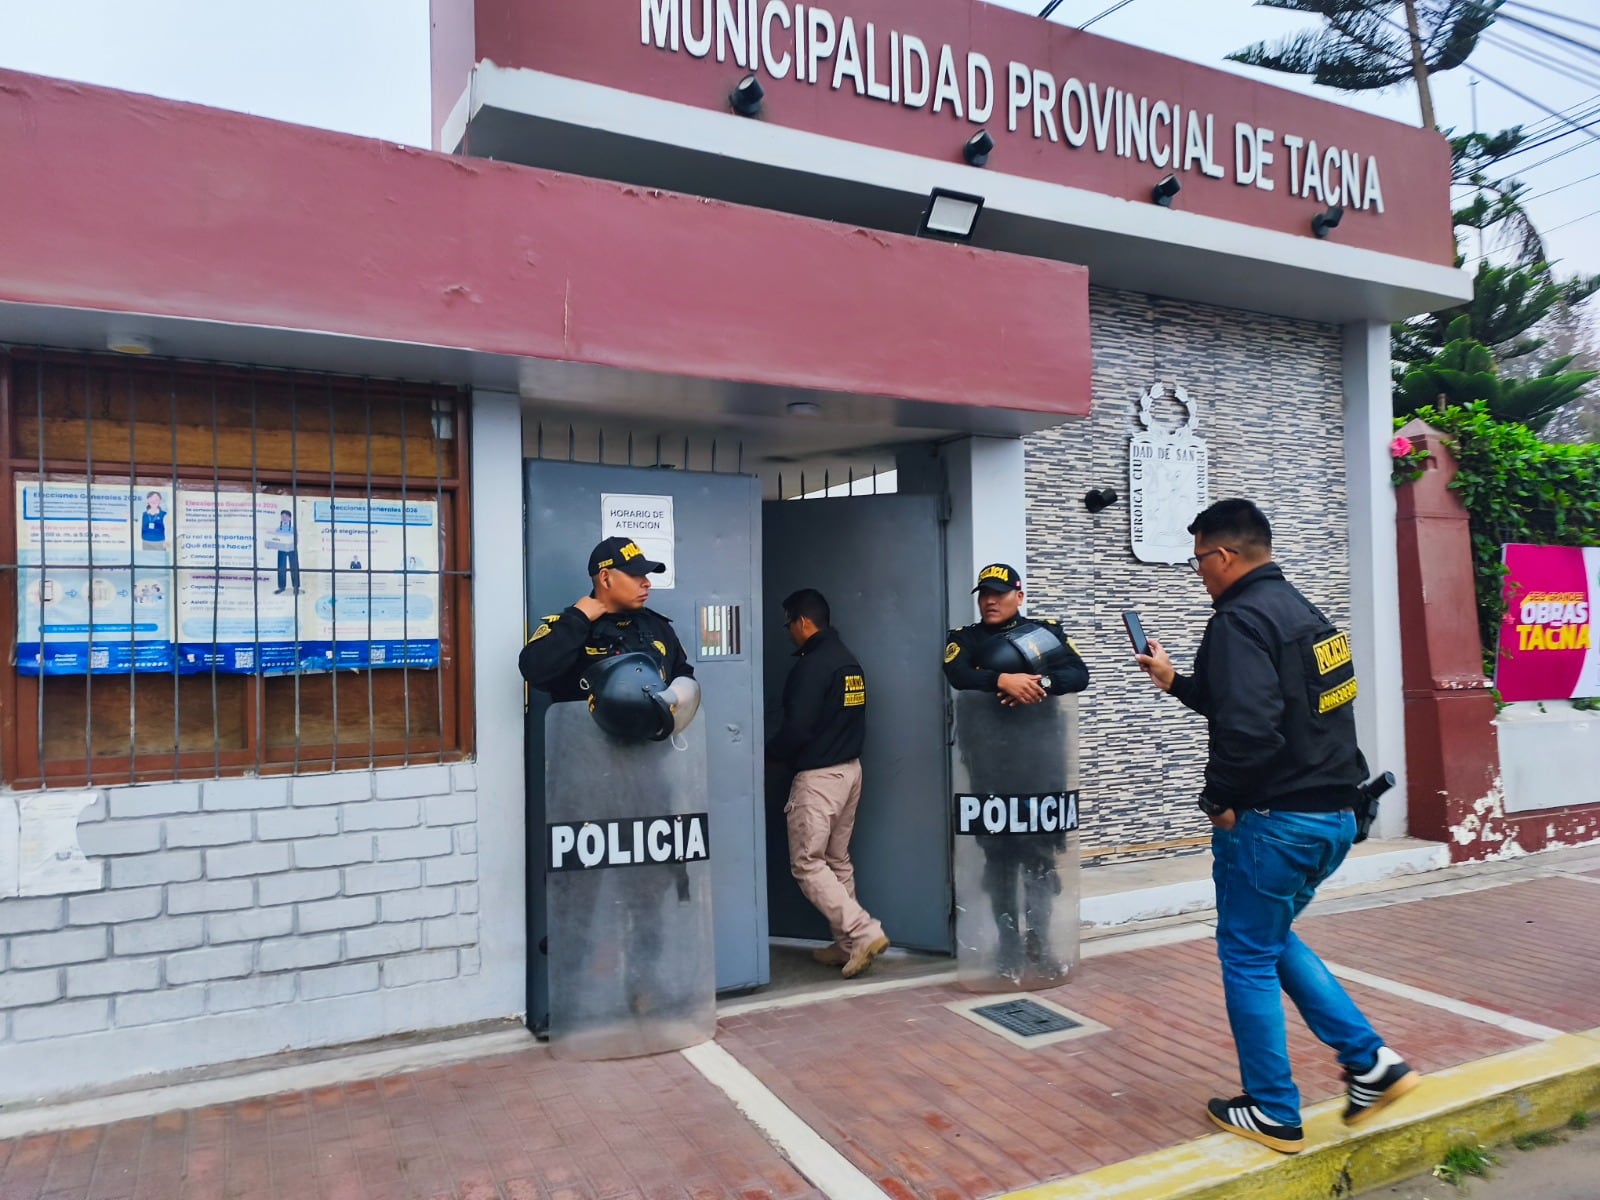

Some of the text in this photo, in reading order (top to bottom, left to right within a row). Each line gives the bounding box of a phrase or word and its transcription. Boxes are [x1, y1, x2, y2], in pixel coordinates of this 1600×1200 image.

[640, 0, 1385, 214] MUNICIPALIDAD PROVINCIAL DE TACNA
[1158, 448, 1170, 460] DE
[1177, 449, 1195, 461] SAN
[80, 493, 122, 501] Gnerales
[610, 509, 664, 518] HORARIO DE
[1133, 488, 1143, 543] HEROICA
[1520, 601, 1589, 626] OBRAS
[1515, 624, 1592, 651] TACNA
[1315, 636, 1350, 671] POLICIA
[959, 794, 1078, 834] POLICIA
[551, 817, 707, 869] POLICIA
